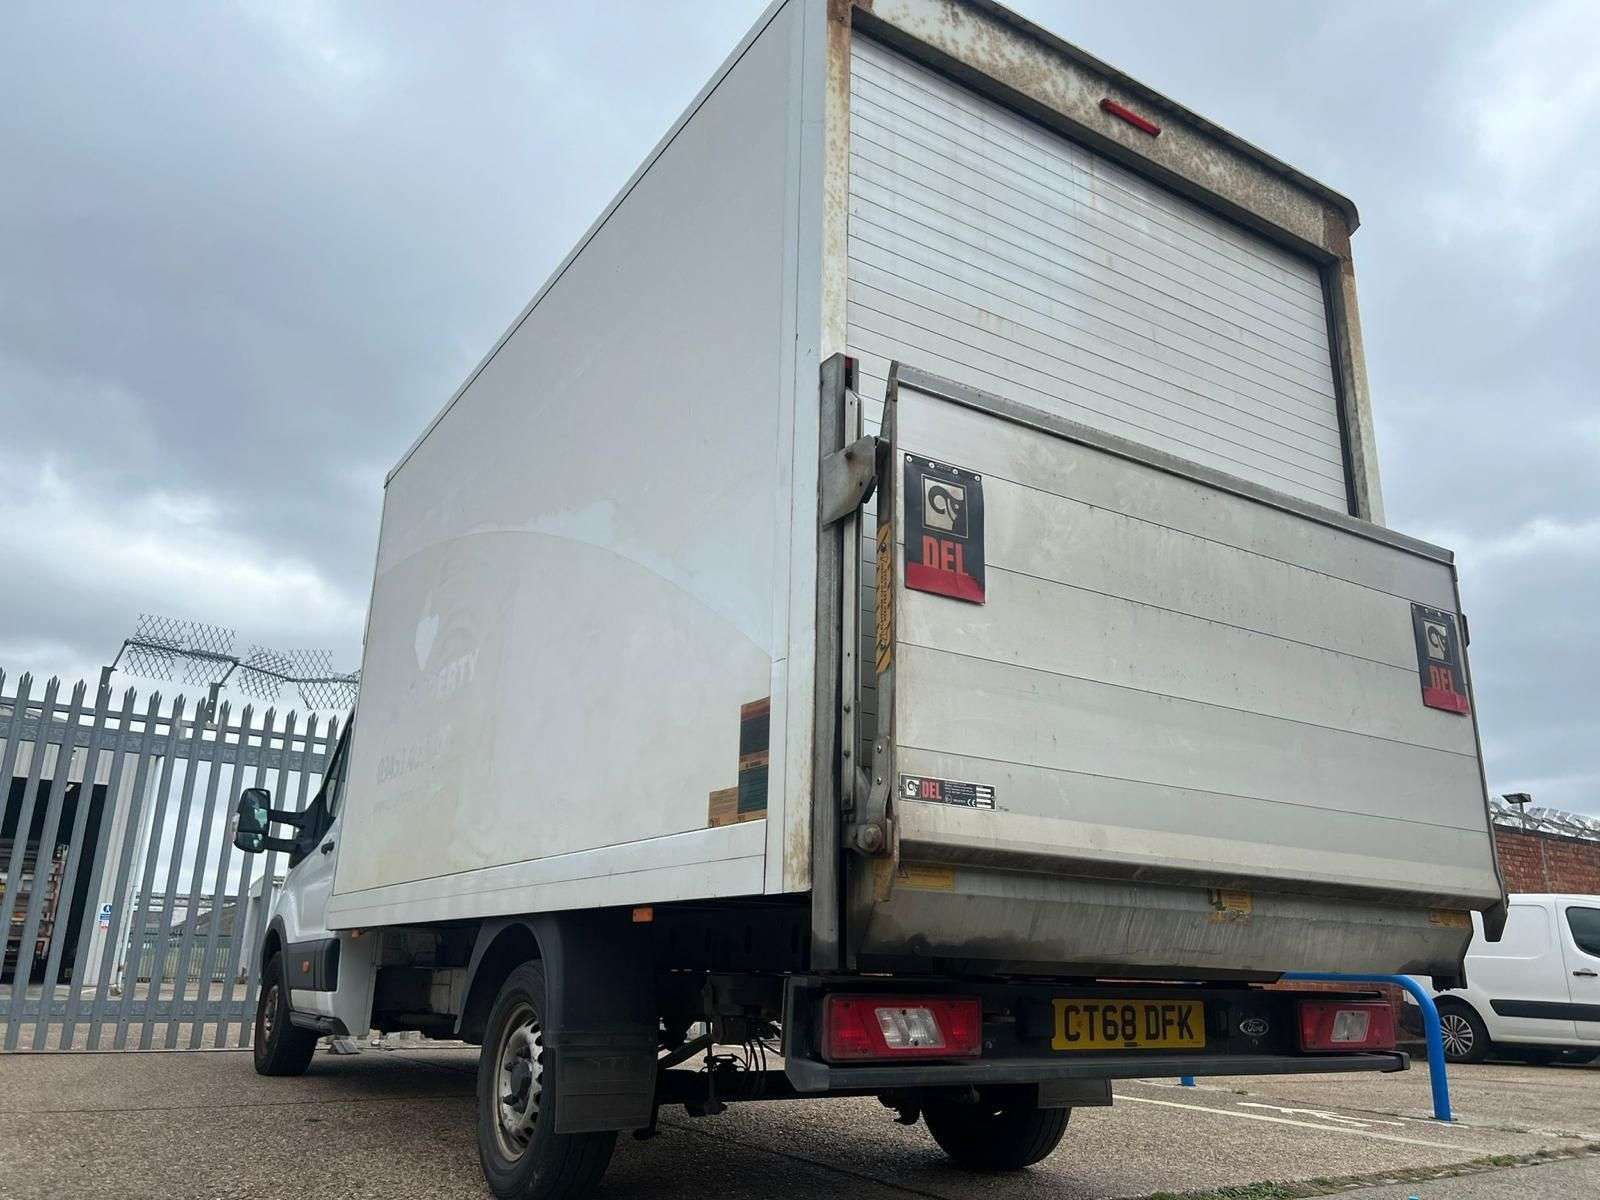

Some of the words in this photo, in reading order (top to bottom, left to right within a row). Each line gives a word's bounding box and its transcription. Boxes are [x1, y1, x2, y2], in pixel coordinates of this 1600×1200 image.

[922, 535, 968, 576] DEL
[1429, 665, 1455, 695] DEL
[922, 780, 942, 800] DEL
[1064, 1004, 1137, 1041] CT68
[1144, 1004, 1194, 1040] DFK
